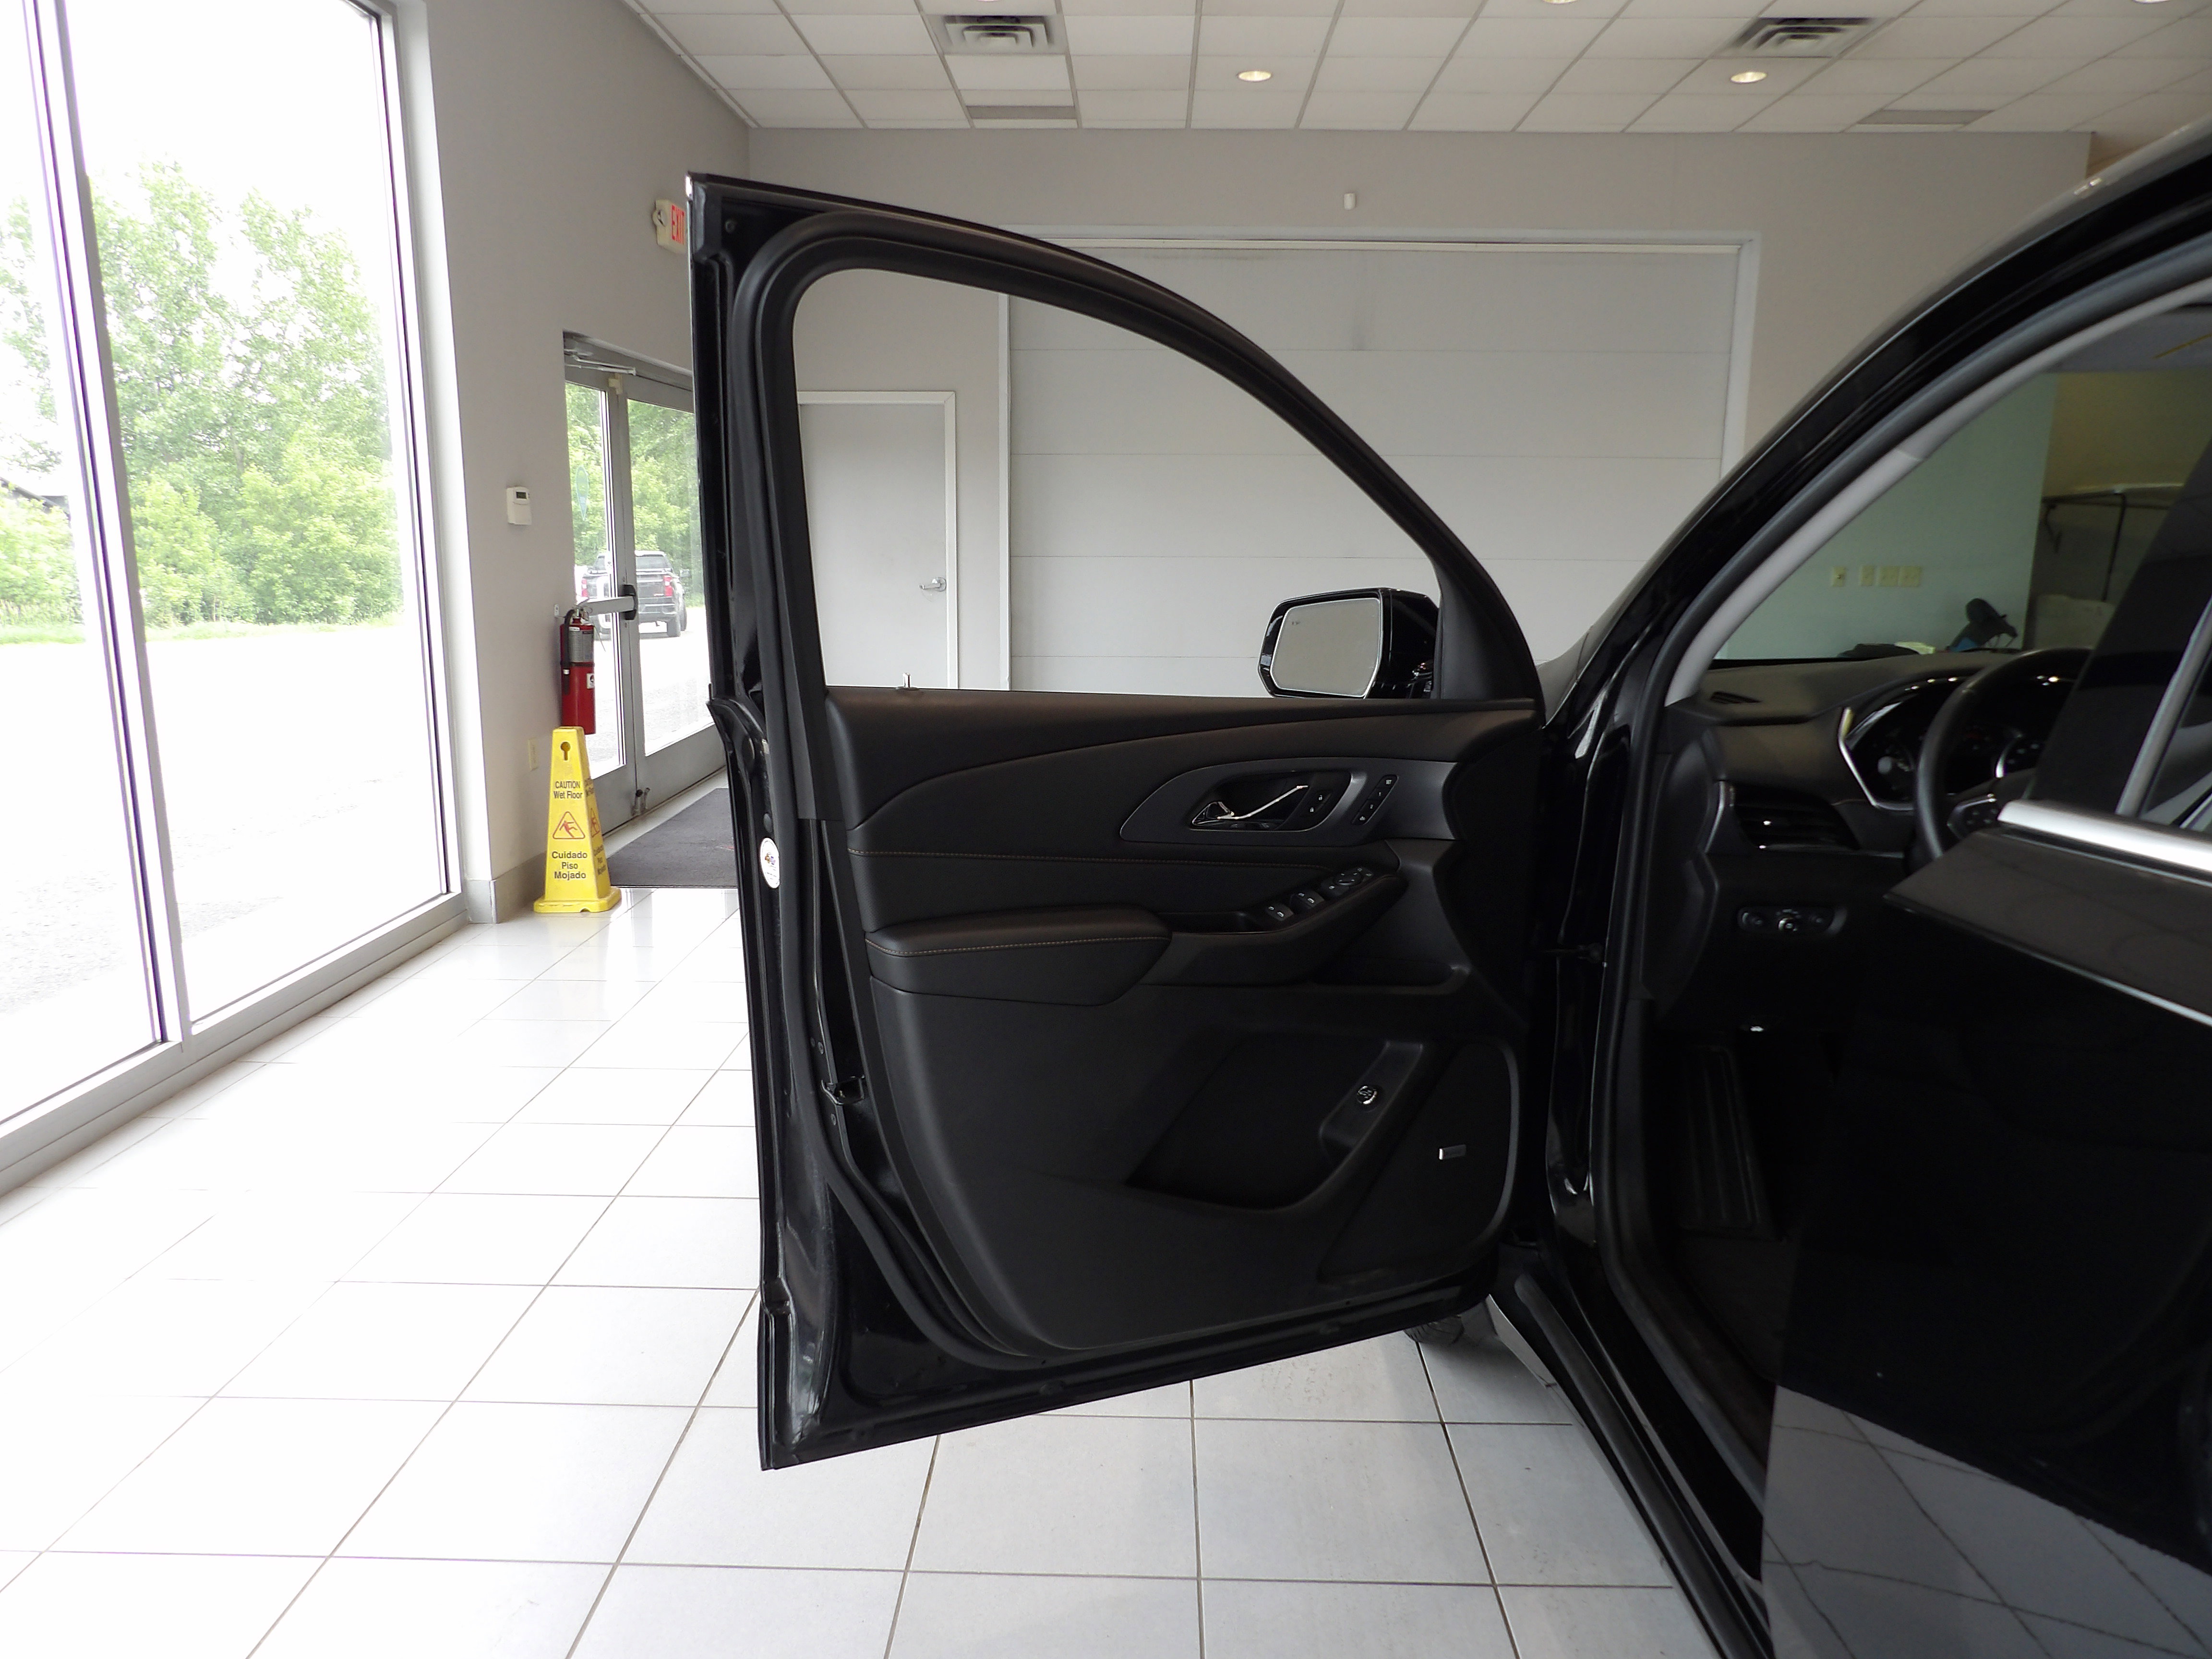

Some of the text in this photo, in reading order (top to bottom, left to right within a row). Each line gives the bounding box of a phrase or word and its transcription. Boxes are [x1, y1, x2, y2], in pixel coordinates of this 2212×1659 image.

[553, 791, 565, 799] Wet
[567, 791, 583, 799] Floor
[554, 871, 586, 880] Mojado
